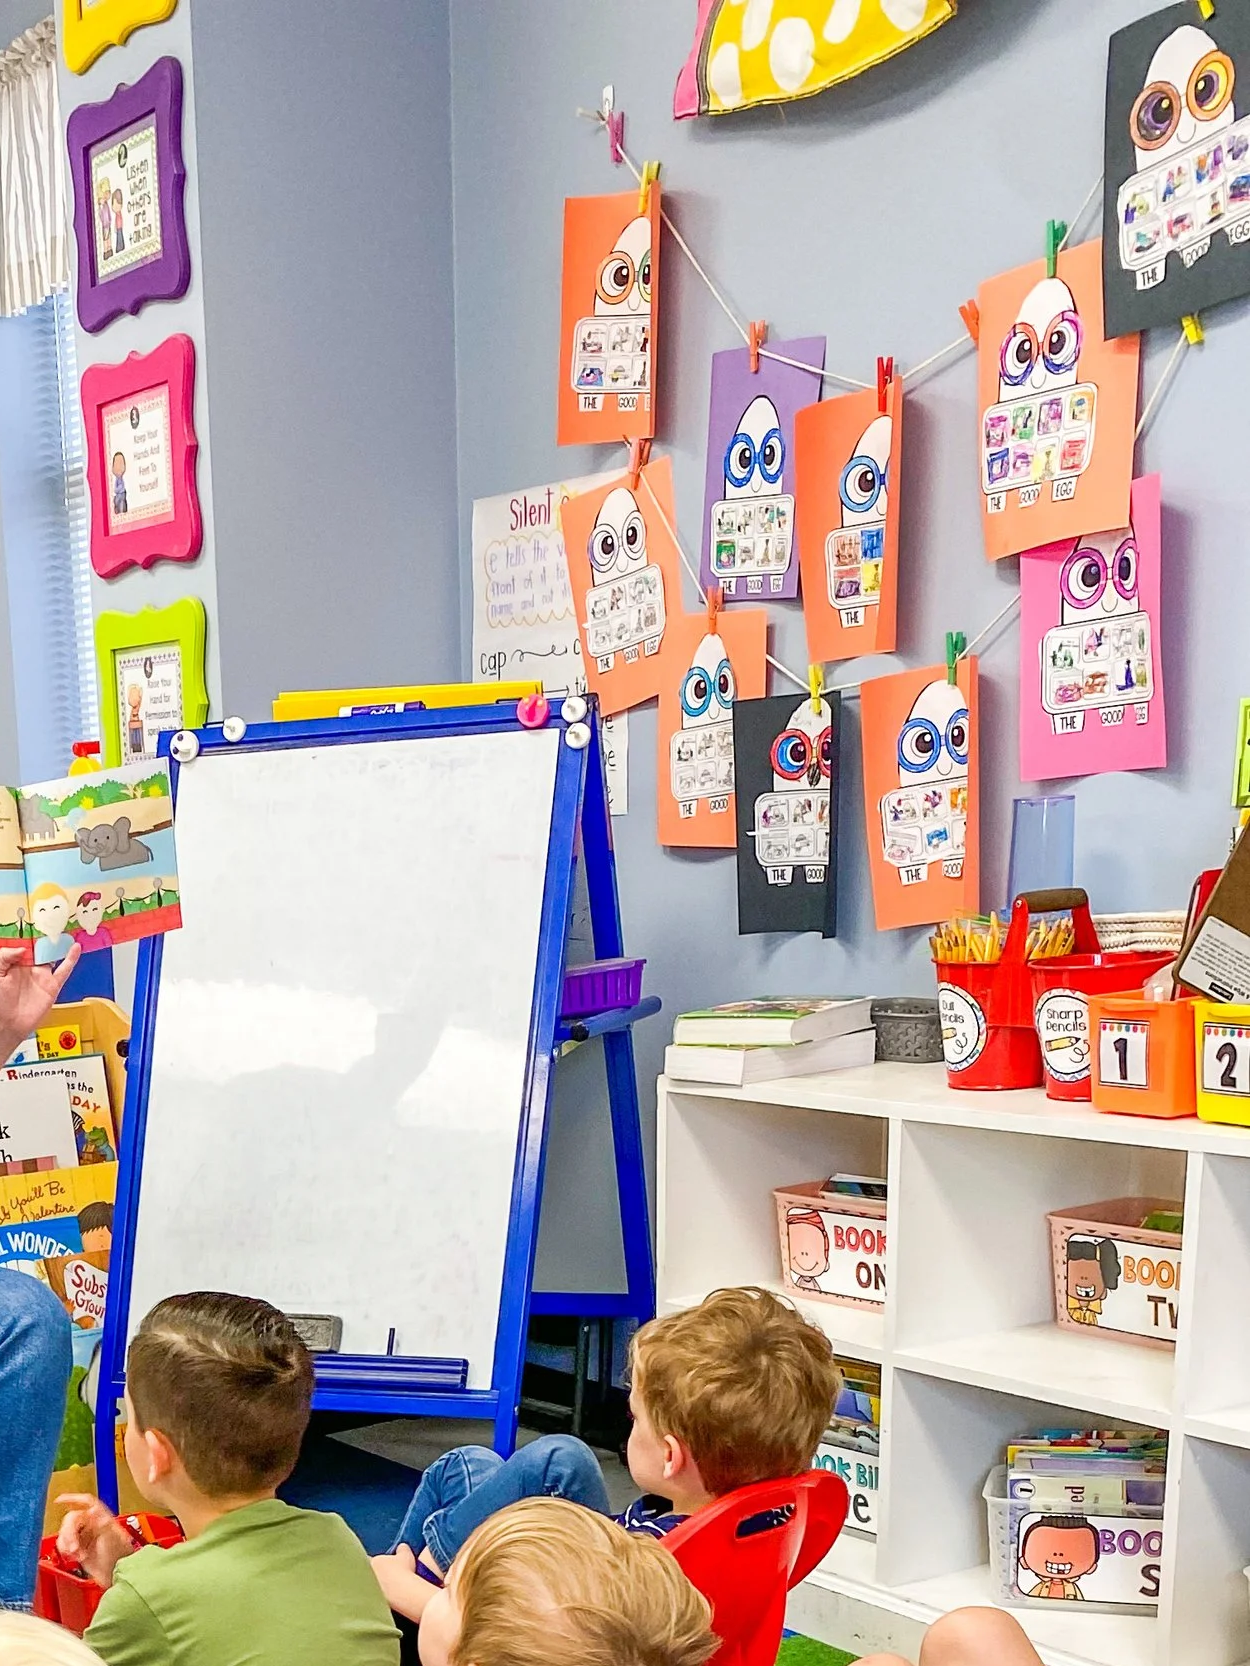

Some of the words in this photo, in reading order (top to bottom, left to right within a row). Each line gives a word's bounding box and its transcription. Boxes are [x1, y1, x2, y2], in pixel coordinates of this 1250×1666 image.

[127, 159, 148, 180] Listen
[127, 191, 151, 213] others
[134, 210, 146, 226] are
[1140, 267, 1159, 287] THE
[1186, 244, 1209, 265] GOOD
[584, 396, 598, 409] THE
[618, 397, 637, 409] GOOD
[989, 497, 1002, 510] THE
[1055, 481, 1073, 497] EGG
[510, 488, 554, 531] Silent
[722, 580, 735, 593] THE
[772, 577, 782, 590] EGG
[846, 611, 860, 625] THE
[480, 651, 507, 680] cap
[600, 657, 612, 672] THE
[1059, 715, 1077, 731] THE
[1101, 708, 1123, 726] GOOD
[1135, 706, 1147, 723] EGG
[681, 803, 693, 816] THE
[709, 799, 729, 813] GOOD
[772, 868, 788, 882] THE
[806, 868, 824, 882] GOOD
[905, 868, 922, 884] THE
[943, 863, 962, 877] GOOD
[941, 1013, 964, 1024] encils
[1046, 1019, 1087, 1032] Pencils
[1047, 1008, 1083, 1022] Sharp
[1112, 1038, 1129, 1081] 1
[1215, 1042, 1238, 1088] 2
[78, 1082, 94, 1094] the
[72, 1095, 101, 1113] DAY
[10, 1186, 44, 1214] You'll
[44, 1181, 65, 1195] Be
[72, 1264, 108, 1299] Subs
[856, 1261, 887, 1290] ON
[856, 1463, 878, 1491] Bi
[1100, 1529, 1162, 1558] BOO
